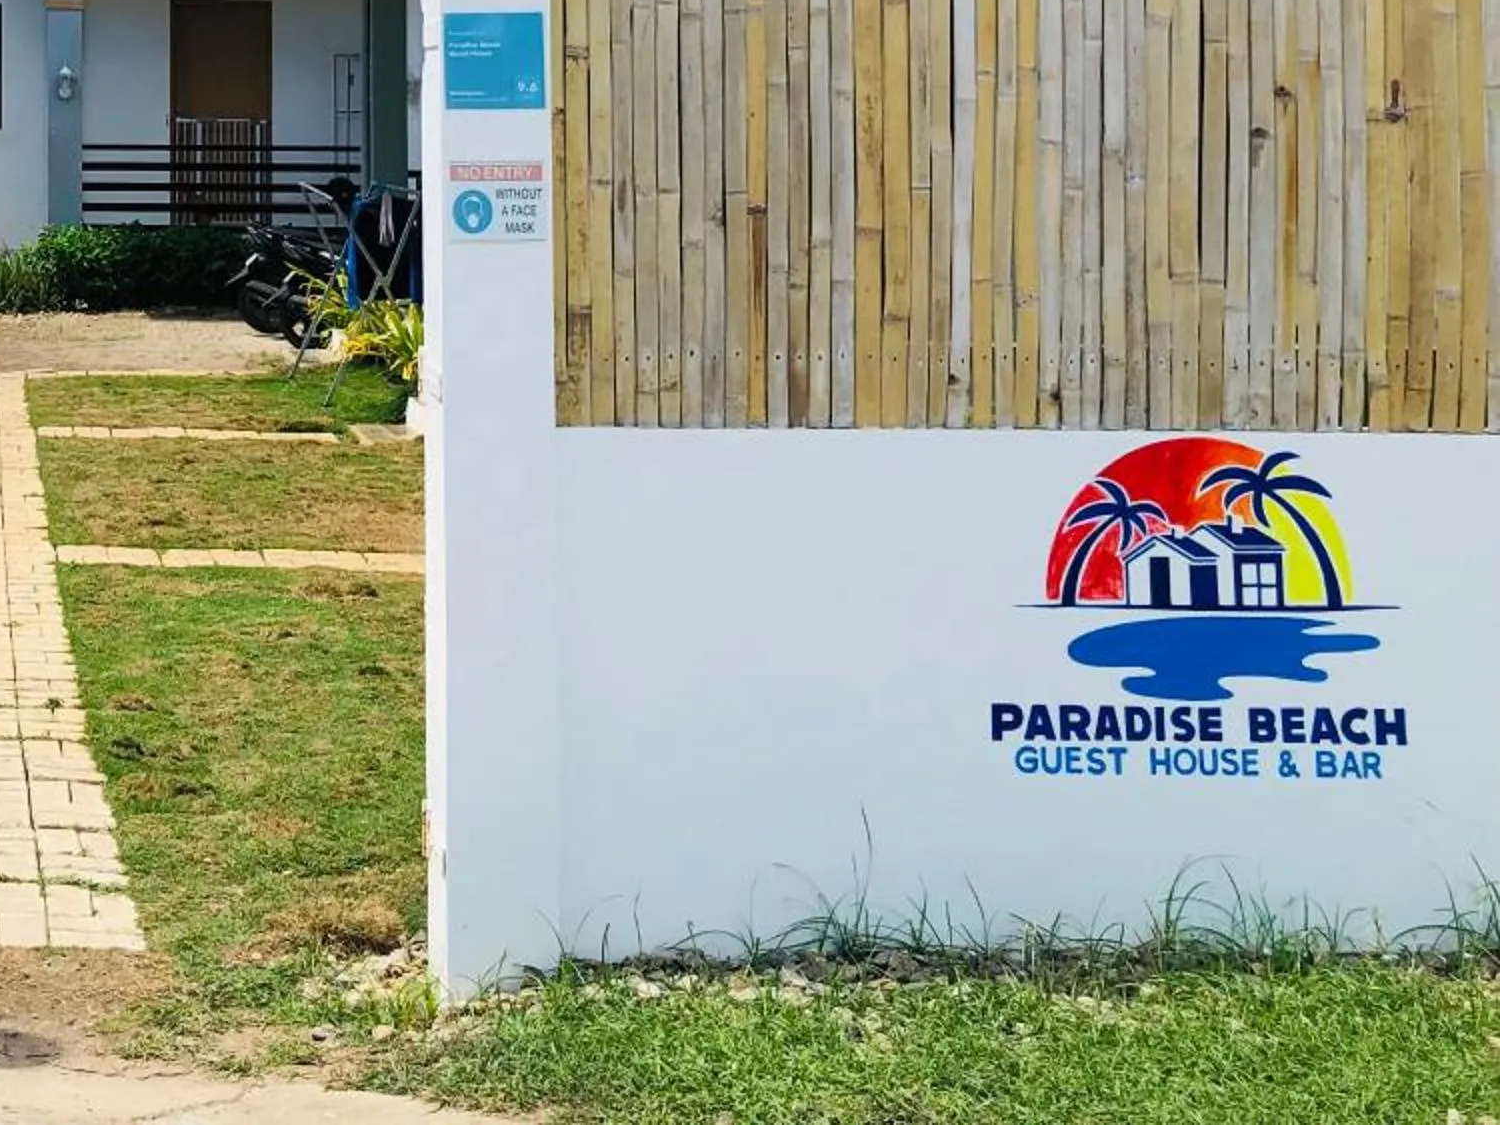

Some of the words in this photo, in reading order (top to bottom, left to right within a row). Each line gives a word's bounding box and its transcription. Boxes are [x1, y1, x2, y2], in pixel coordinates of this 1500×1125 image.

[457, 166, 479, 179] NO
[481, 166, 533, 179] ENTRY
[496, 188, 543, 200] WITHOUT
[501, 205, 509, 217] A
[511, 204, 537, 217] FACE
[505, 222, 535, 234] MASK
[991, 703, 1223, 742] PARADISE
[1248, 707, 1408, 745] BEACH
[1015, 746, 1128, 775] GUEST
[1150, 748, 1259, 776] HOUSE
[1279, 749, 1300, 779] &
[1315, 750, 1382, 779] BAR
